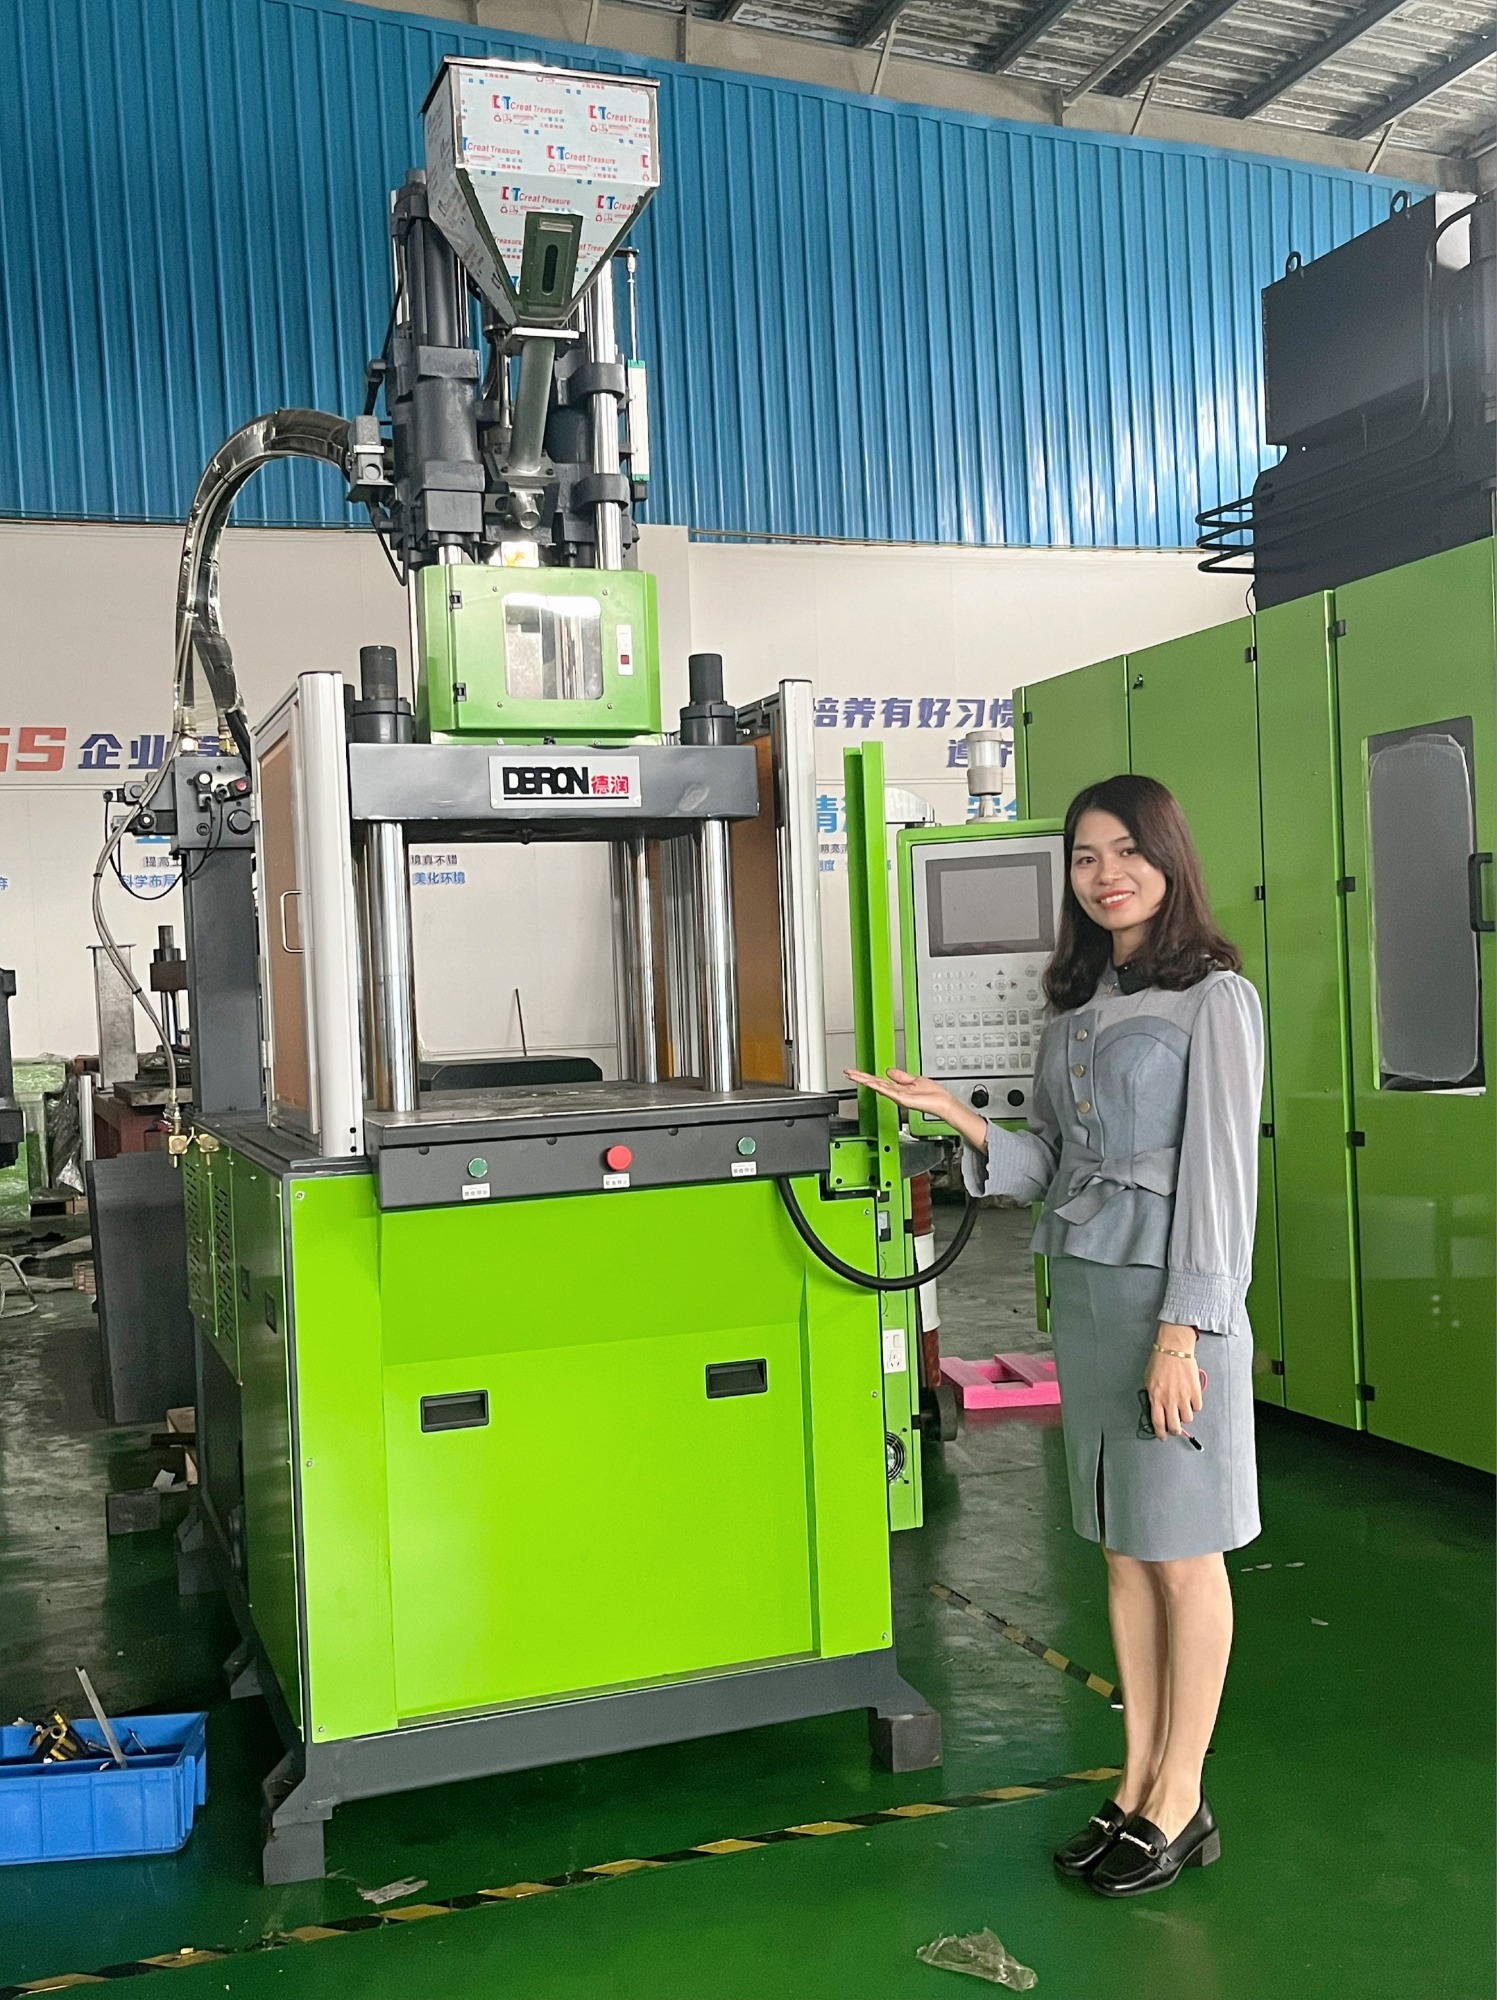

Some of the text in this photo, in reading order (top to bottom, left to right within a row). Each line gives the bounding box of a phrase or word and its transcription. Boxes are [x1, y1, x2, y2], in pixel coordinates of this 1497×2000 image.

[490, 145, 521, 155] Treasure
[502, 766, 629, 795] DERON 德润
[413, 872, 466, 885] 美化环境
